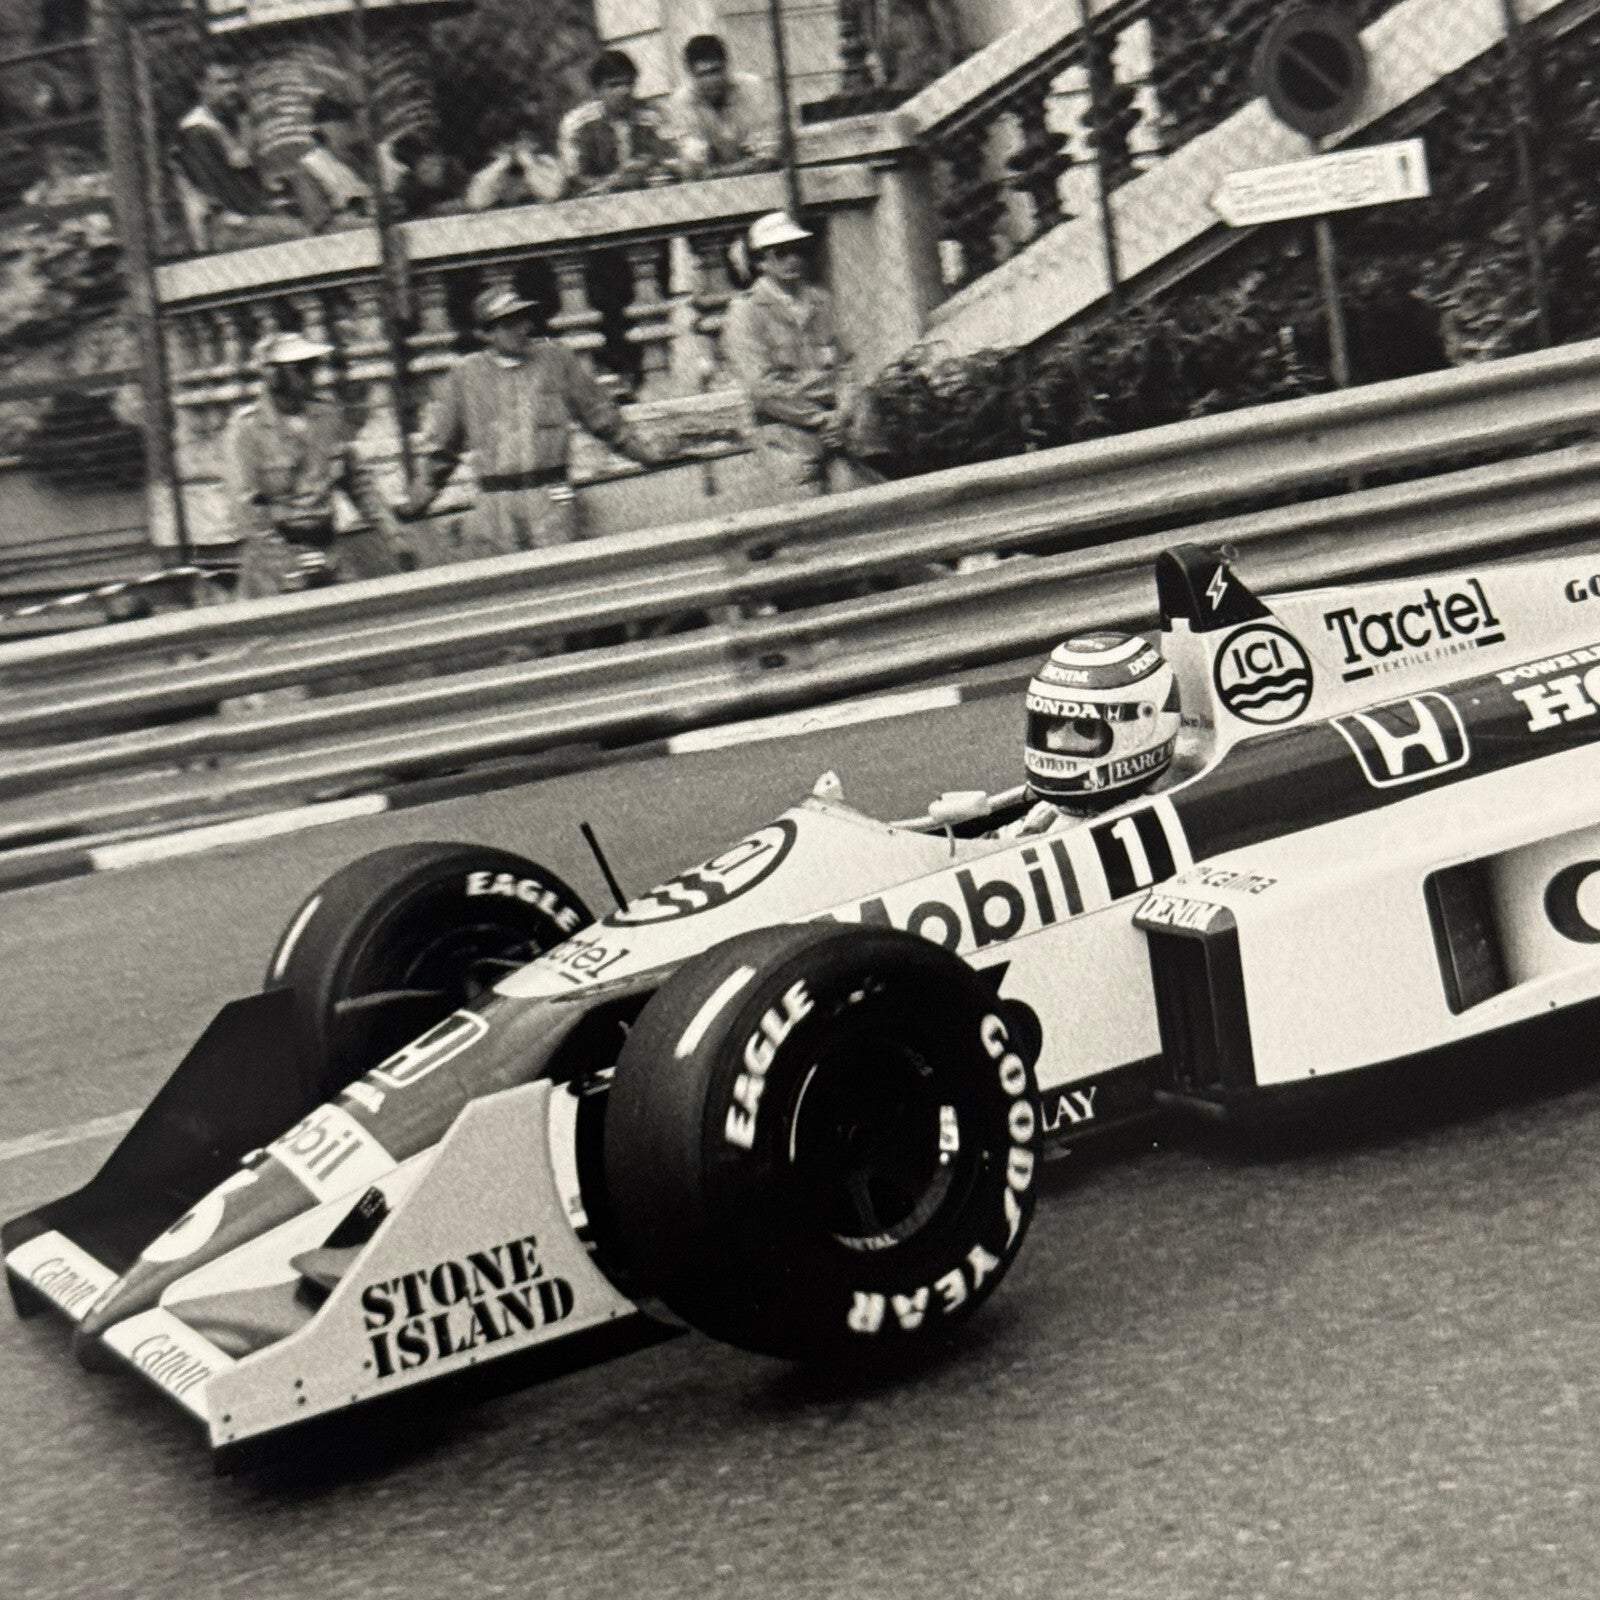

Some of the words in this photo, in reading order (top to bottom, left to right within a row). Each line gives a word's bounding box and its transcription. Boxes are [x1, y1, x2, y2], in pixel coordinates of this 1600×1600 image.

[1323, 578, 1501, 664] Tactel
[1231, 638, 1285, 680] ICI
[1374, 650, 1432, 676] TEXTILE
[1110, 815, 1154, 889] 1
[465, 871, 582, 934] EAGLE
[1134, 891, 1223, 933] DENIM
[724, 977, 816, 1151] EAGLE
[29, 1256, 99, 1312] Canon
[360, 1233, 545, 1332] STONE
[369, 1276, 575, 1379] ISLAND
[131, 1333, 211, 1397] Canon
